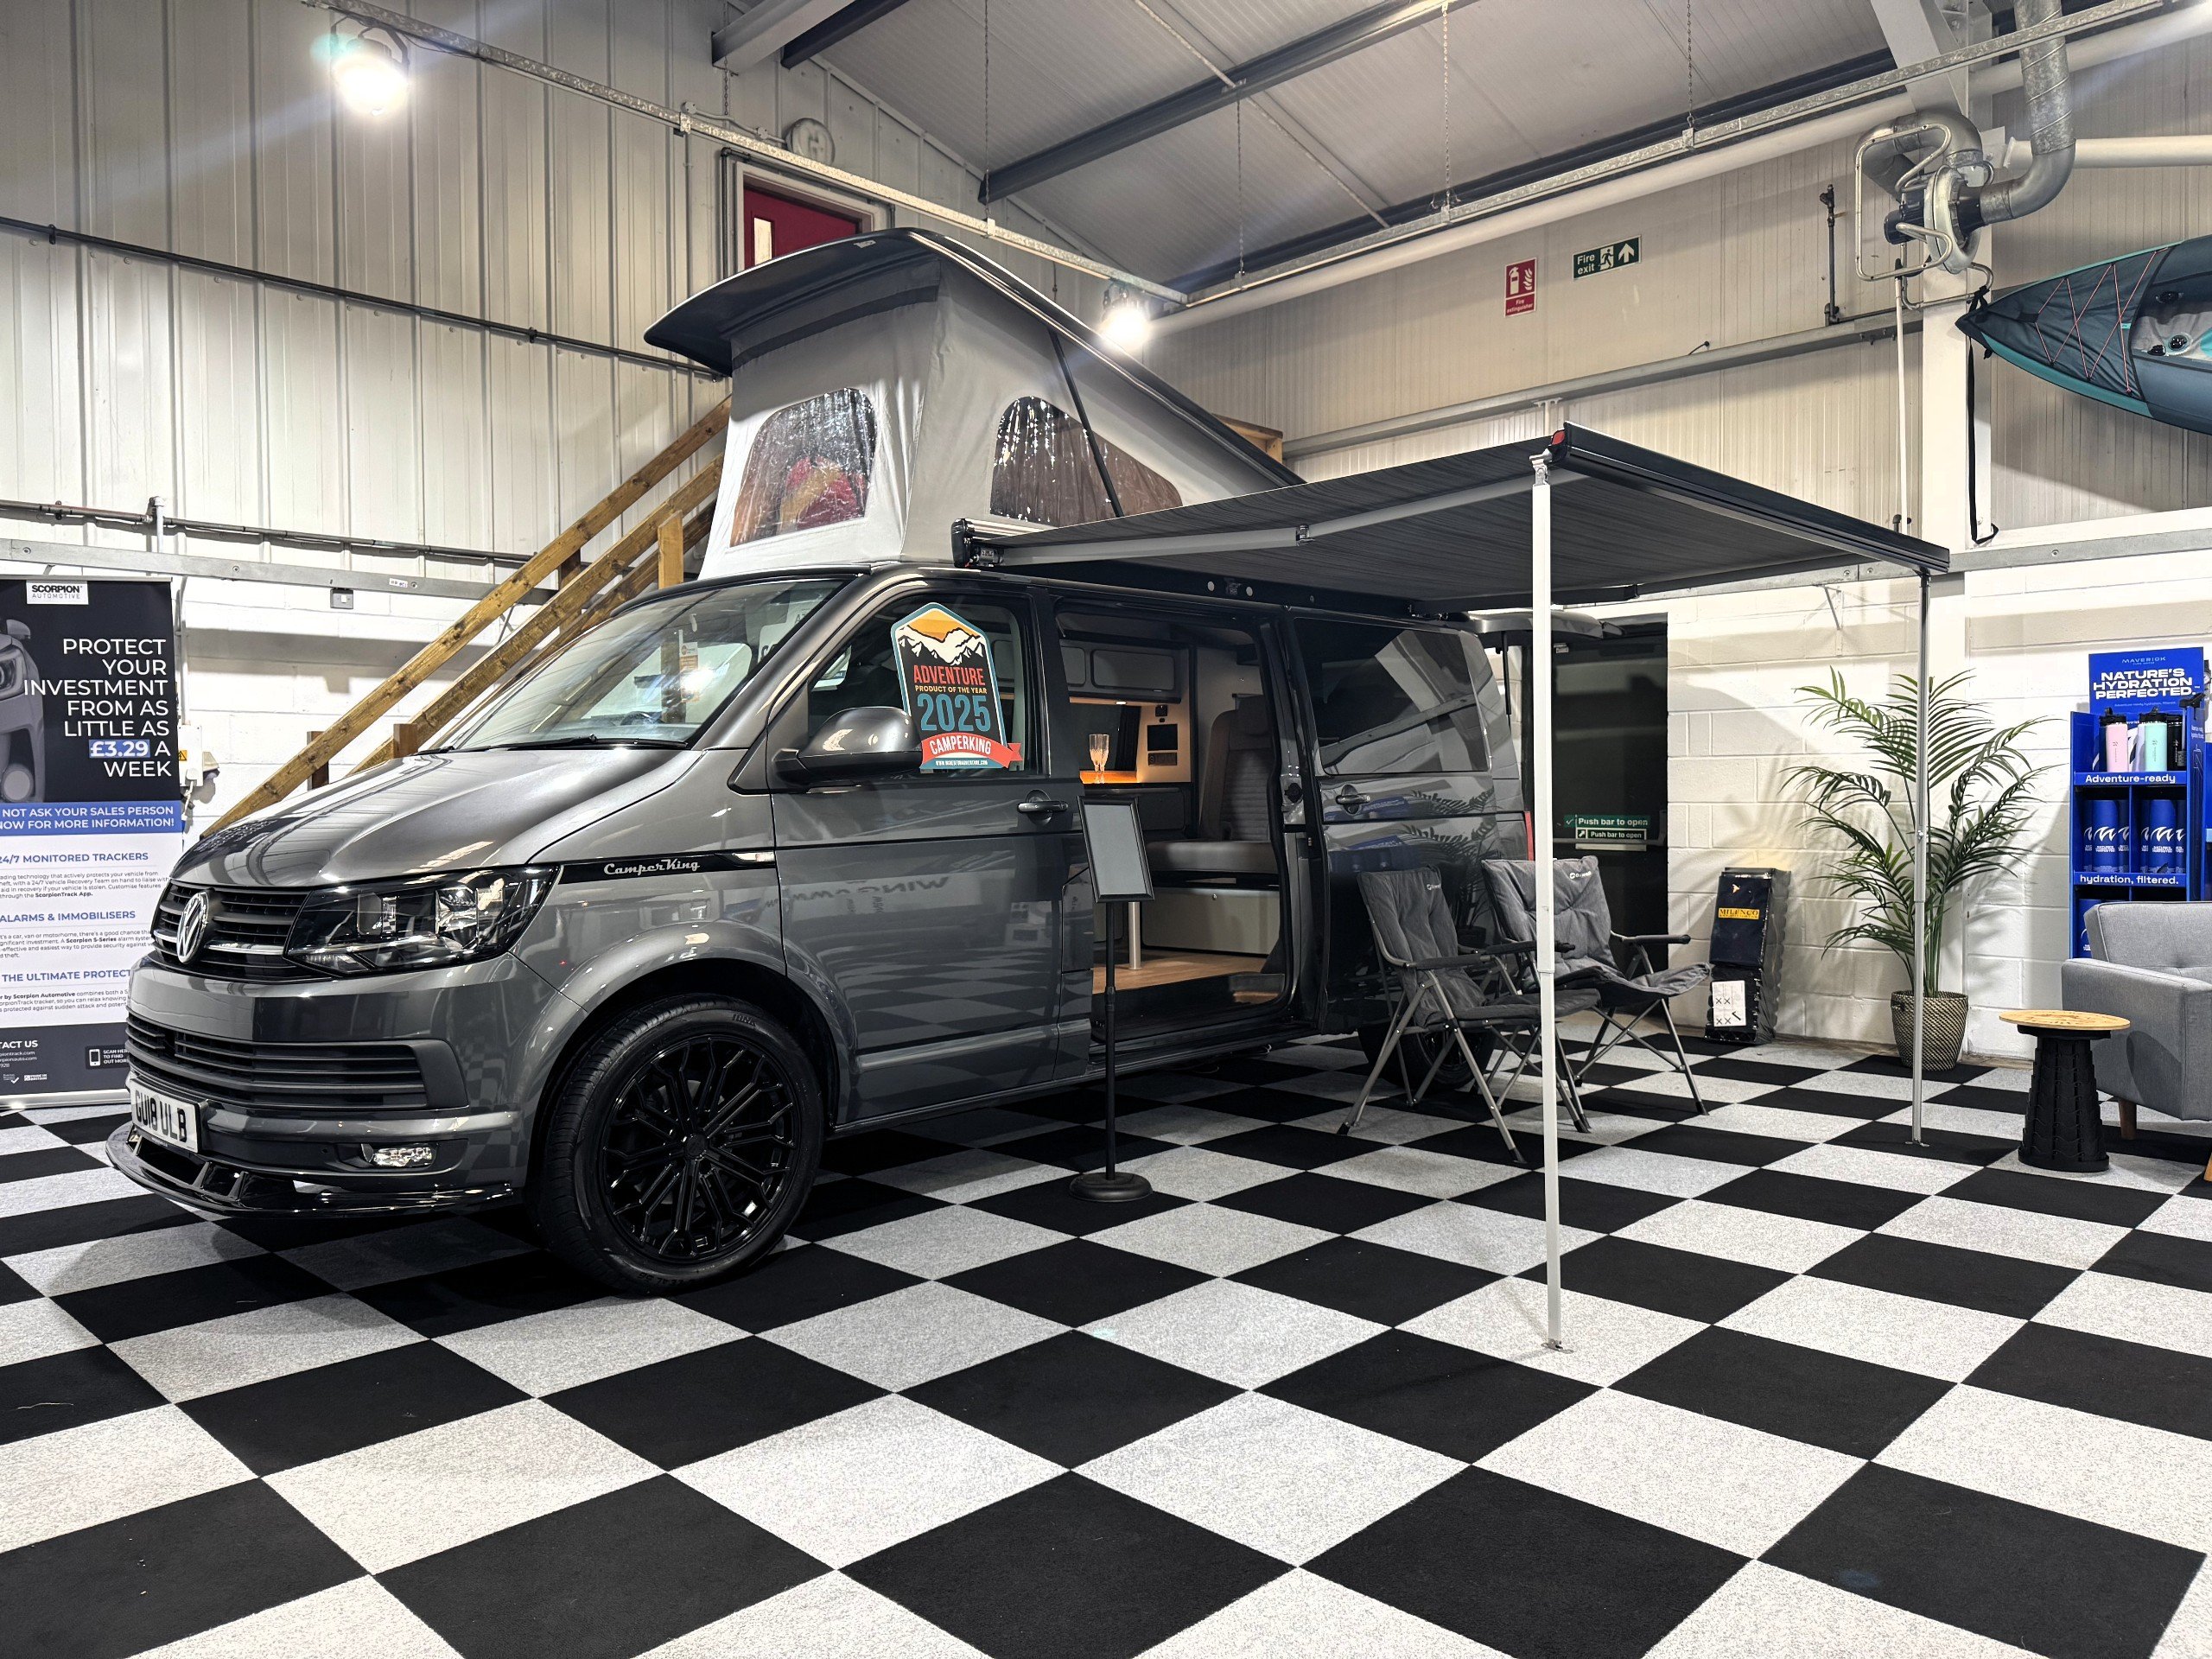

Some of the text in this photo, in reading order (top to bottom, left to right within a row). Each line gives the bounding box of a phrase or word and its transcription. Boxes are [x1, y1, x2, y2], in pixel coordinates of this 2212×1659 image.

[1577, 254, 1595, 264] Fire
[1577, 264, 1595, 275] exit
[31, 585, 80, 594] SCORPION
[63, 639, 166, 655] PROTECT
[102, 659, 167, 676] YOUR
[913, 664, 986, 686] ADVENTURE
[2101, 668, 2184, 681] NATURE'S
[24, 679, 168, 696] INVESTMENT
[2093, 677, 2193, 690] HYDRATION
[2095, 687, 2196, 700] PERFECTED.
[67, 700, 168, 716] FROM AS
[917, 693, 991, 732] 2025
[65, 721, 169, 737] LITTLE AS
[90, 741, 171, 757] £3.29 A
[929, 735, 992, 755] CAMPERKING
[104, 761, 172, 777] WEEK
[2085, 774, 2176, 784] Adventure-ready
[2, 806, 174, 817] NOT ASK YOUR SALES PERSON
[28, 820, 51, 830] FOR
[54, 819, 89, 829] MORE
[92, 817, 175, 828] INFORMATION!
[1578, 817, 1599, 826] Push
[1627, 818, 1648, 828] open
[23, 854, 90, 863] MONITORED
[92, 852, 149, 861] TRACKERS
[604, 858, 701, 875] CamperKing
[2080, 874, 2179, 884] hydration, filtered.
[0, 913, 45, 923] ALARMS
[58, 910, 136, 921] IMMOBILISERS
[2, 969, 131, 982] THE ULTIMATE PROTECT
[24, 1039, 39, 1048] US
